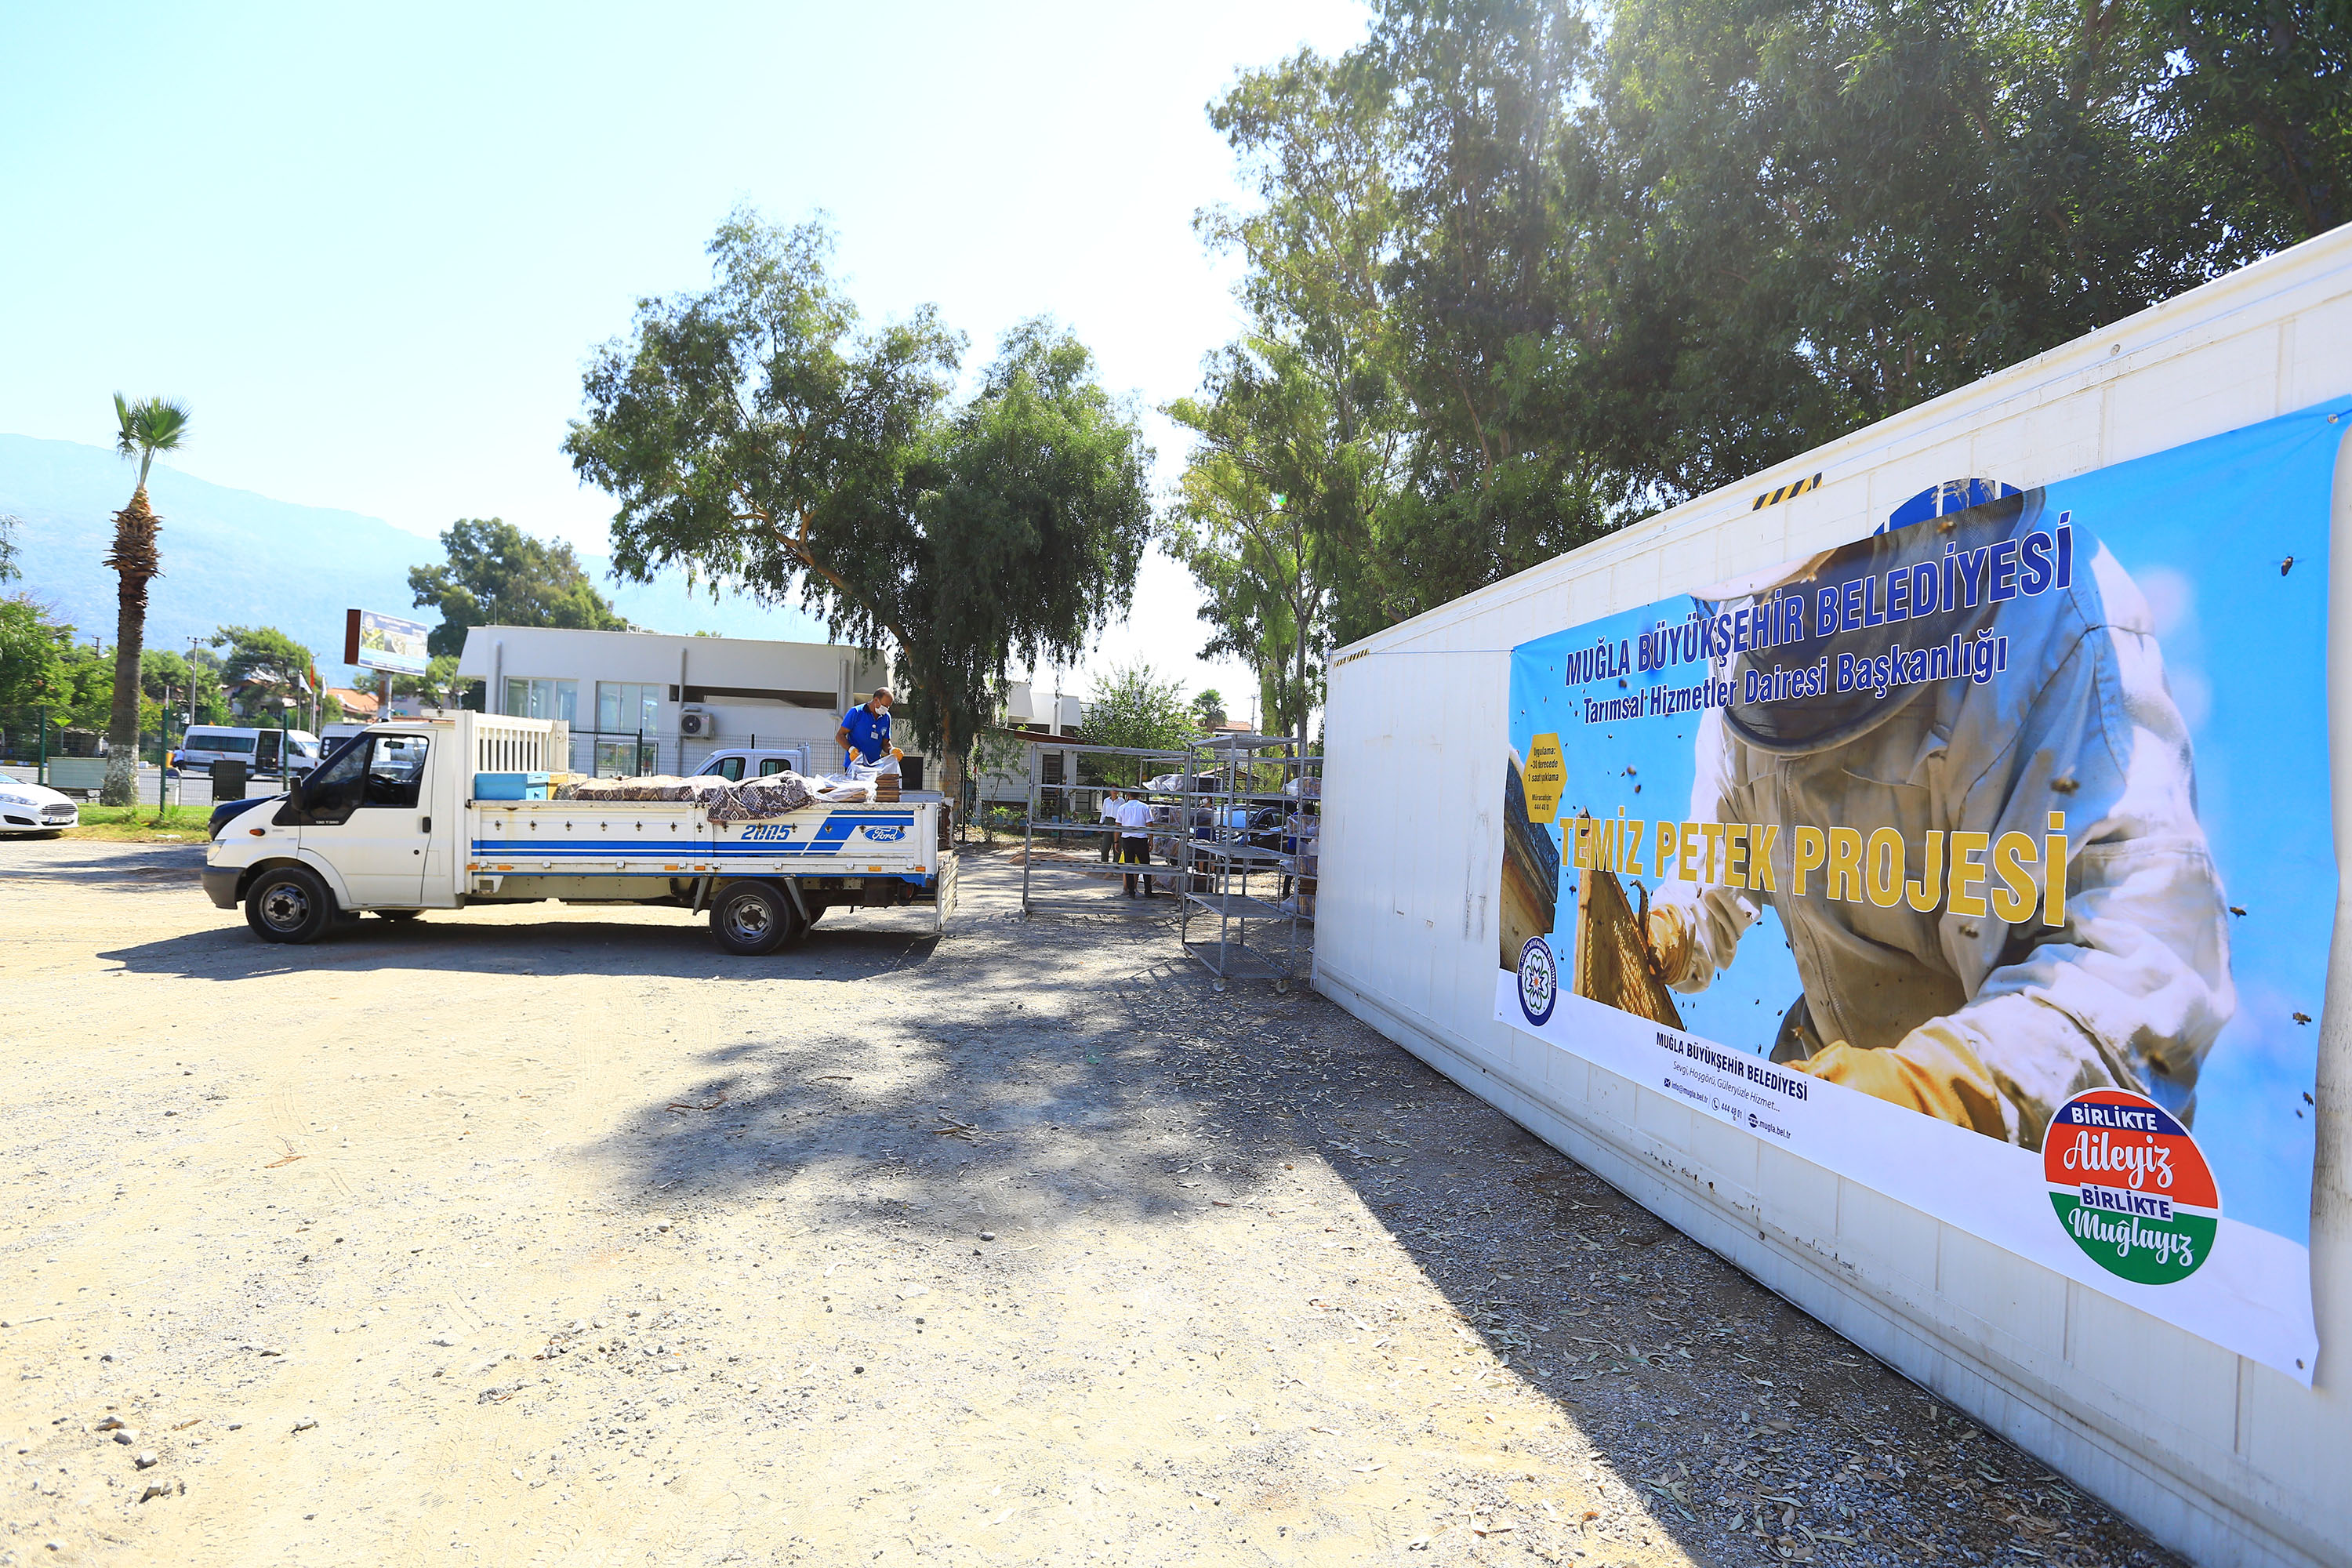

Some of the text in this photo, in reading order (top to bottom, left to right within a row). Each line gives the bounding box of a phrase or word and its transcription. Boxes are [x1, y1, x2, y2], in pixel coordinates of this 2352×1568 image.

[1566, 510, 2072, 687] MUĞLA BÜYÜKŞEHİR BELEDİYESİ
[1584, 627, 2008, 724] Tarımsal Hizmetler Dairesi Başkanlığı
[741, 825, 790, 840] 2005
[872, 828, 897, 840] Ford
[1559, 805, 2067, 927] TEMİZ PETEK PROJESİ
[1657, 1032, 1807, 1102] MUĞLA BÜYÜKŞEHİR BELEDİYESİ
[1673, 1061, 1780, 1112] Sevgi, Hoşgörü, Güleryüzle Hizmet...
[1721, 1102, 1730, 1112] 444
[2071, 1103, 2158, 1131] BİRLİKTE
[2063, 1130, 2176, 1189] Aileyiz
[2082, 1185, 2171, 1218] BİRLİKTE
